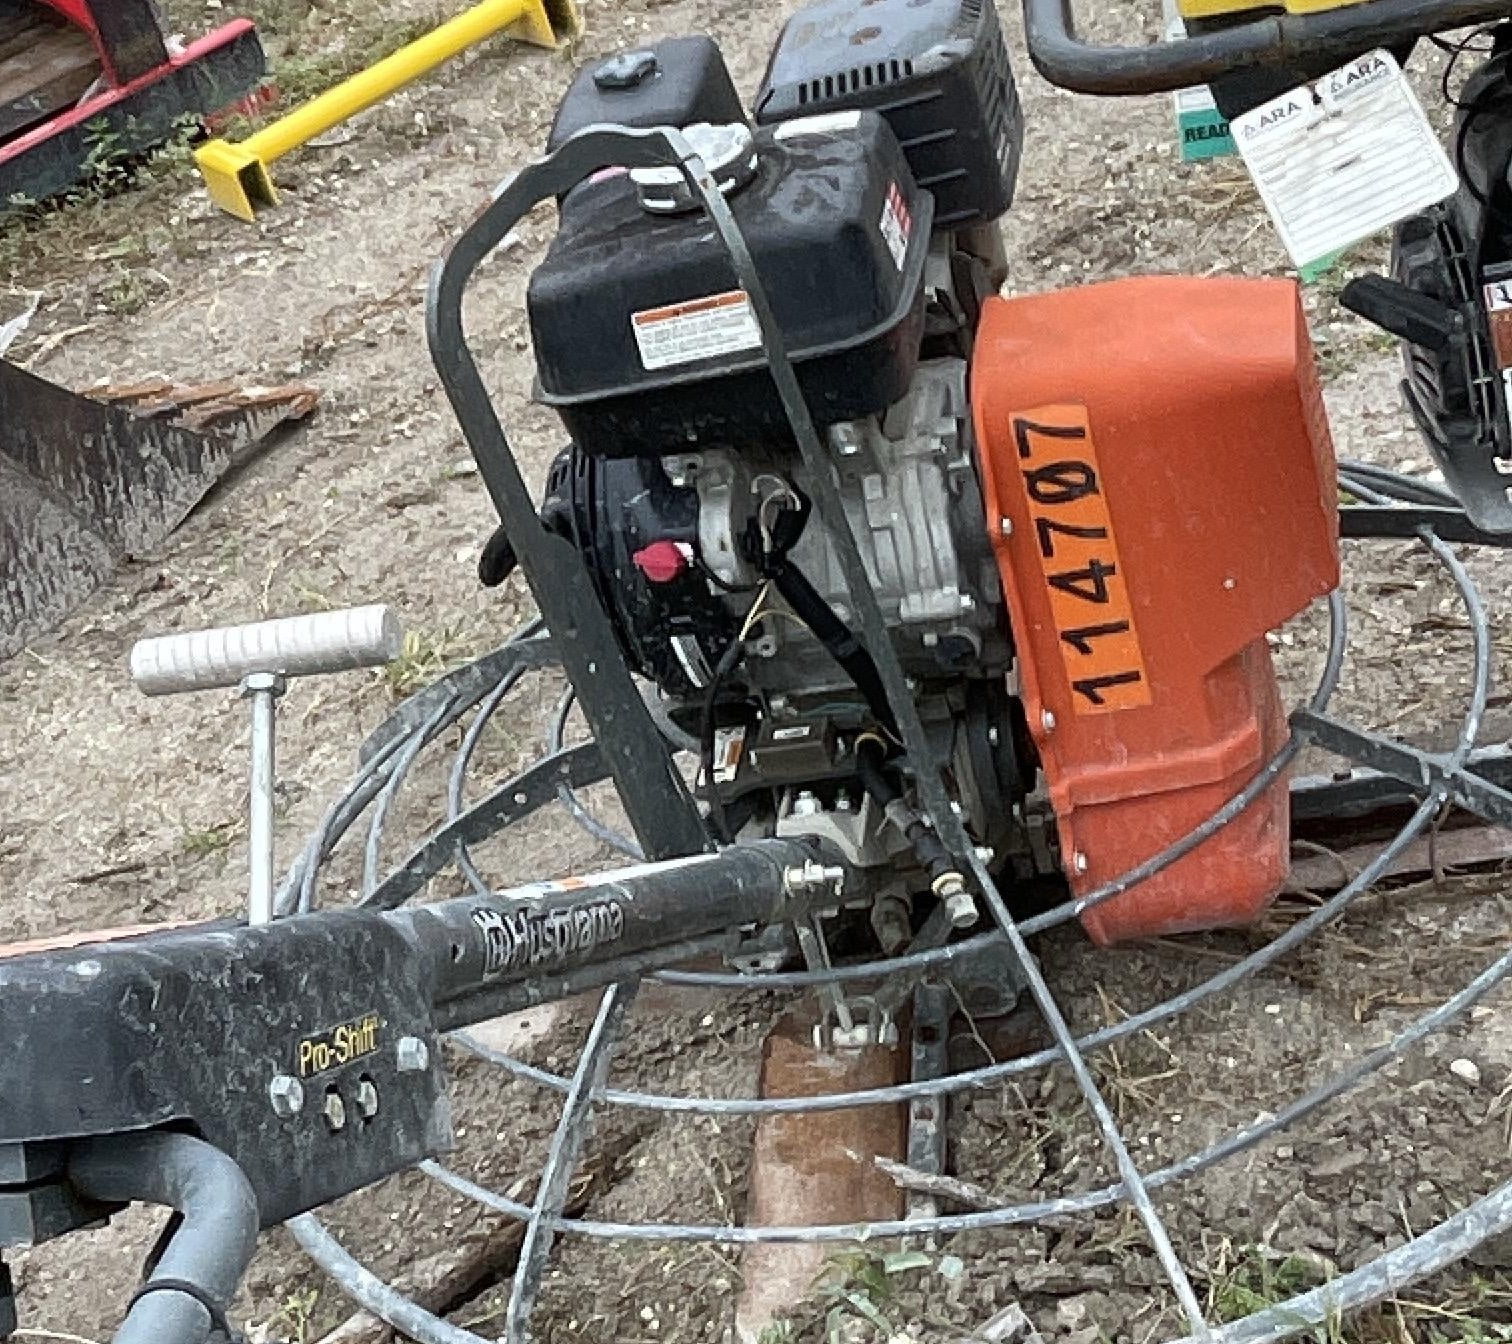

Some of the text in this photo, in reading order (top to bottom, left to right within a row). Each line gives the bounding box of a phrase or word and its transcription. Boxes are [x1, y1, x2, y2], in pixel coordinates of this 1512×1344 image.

[1257, 101, 1302, 128] ARA
[1014, 418, 1142, 704] 114707
[299, 1016, 378, 1078] Pro-Shift
